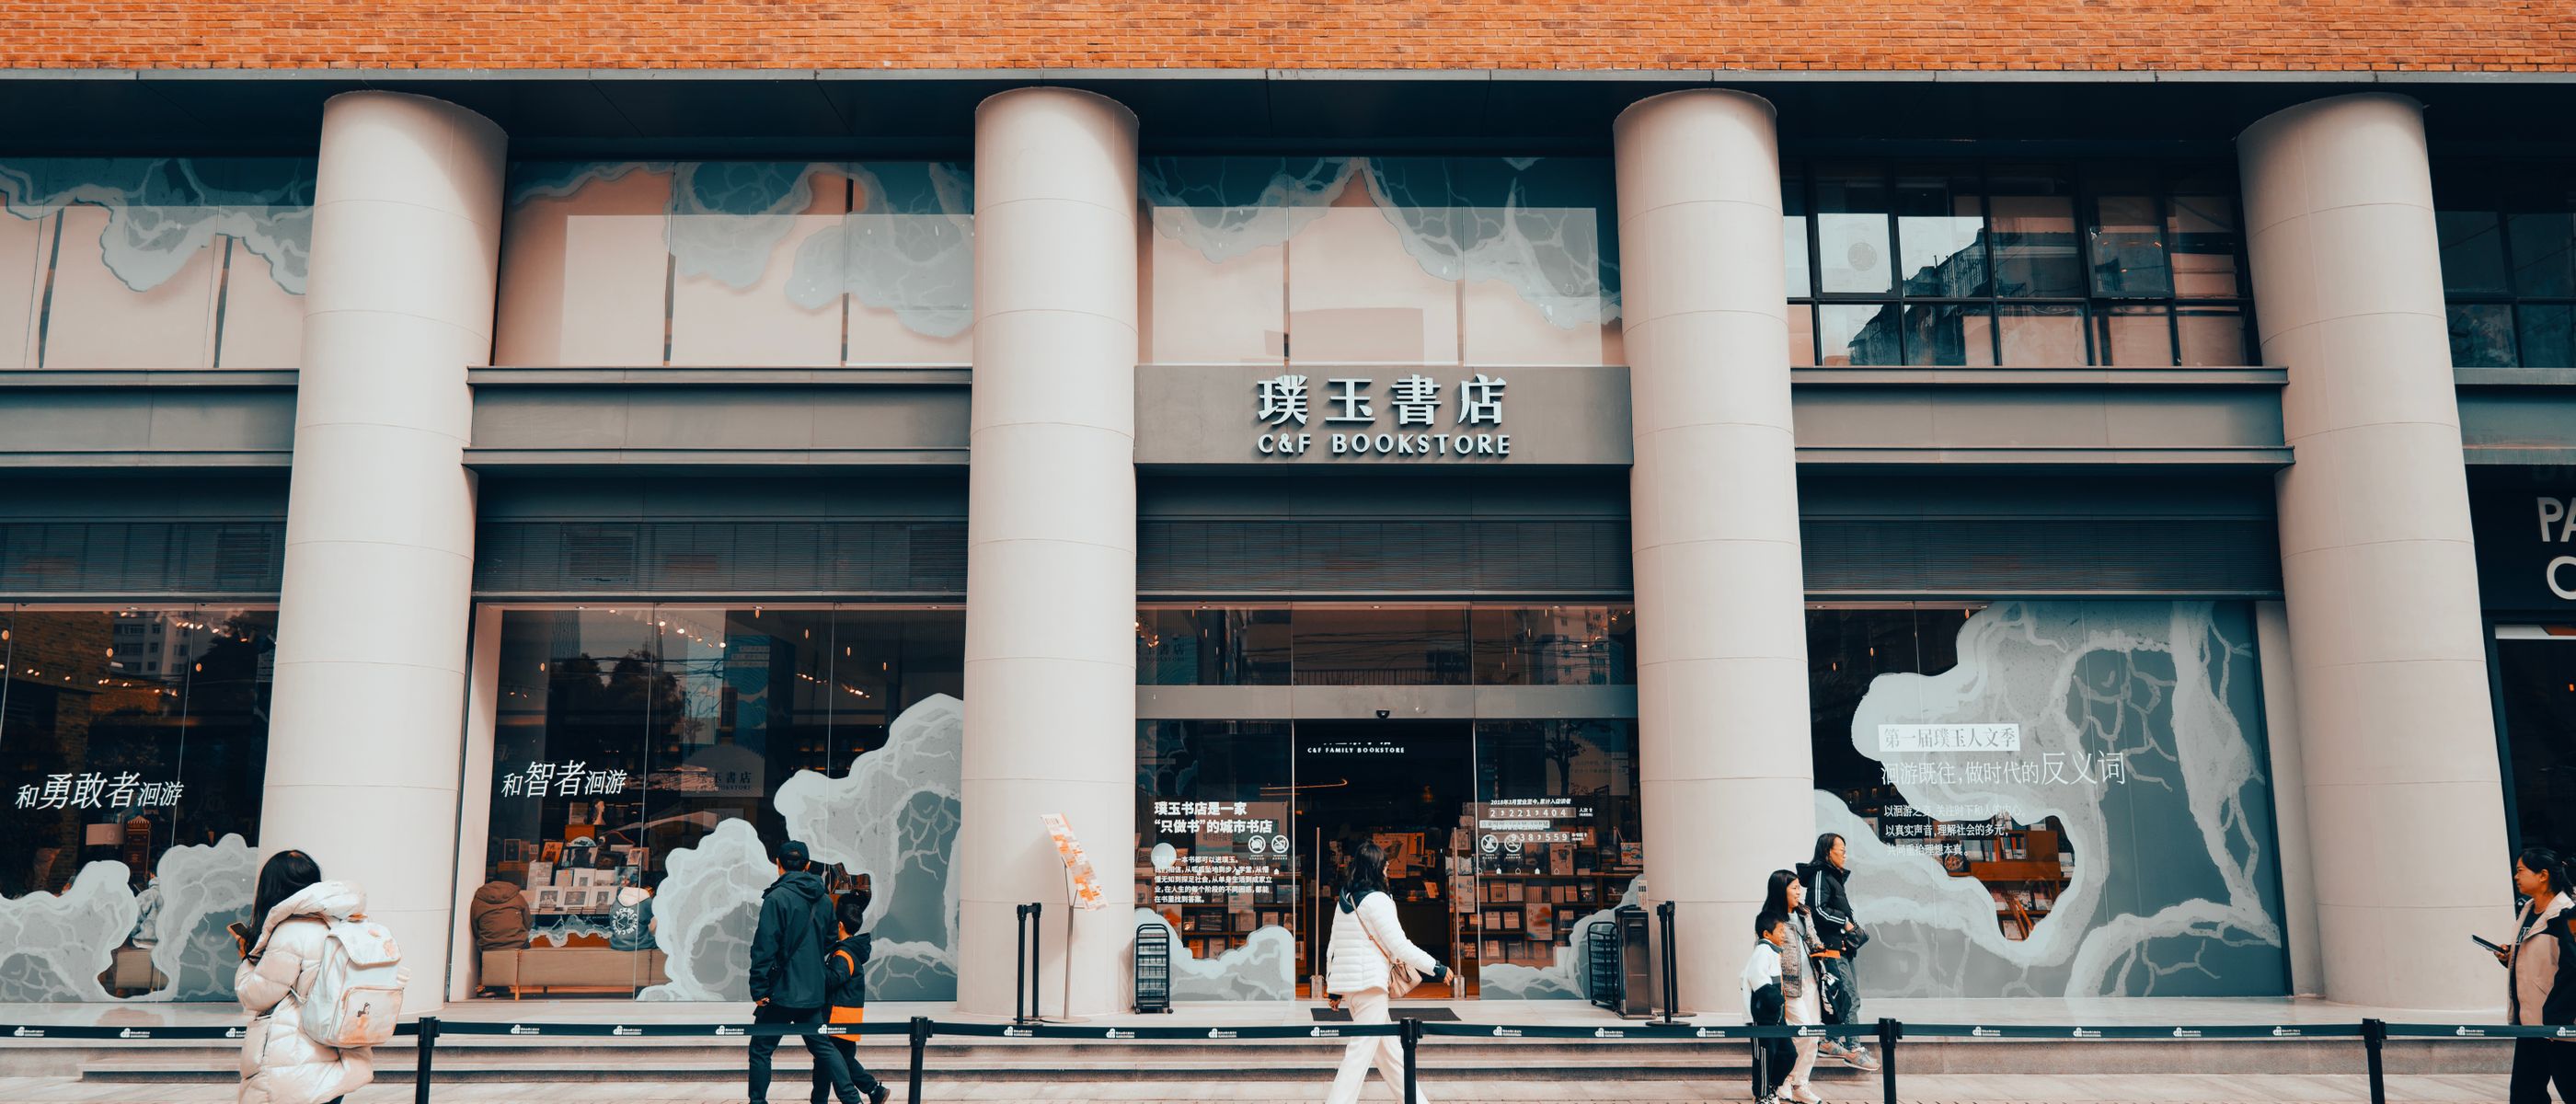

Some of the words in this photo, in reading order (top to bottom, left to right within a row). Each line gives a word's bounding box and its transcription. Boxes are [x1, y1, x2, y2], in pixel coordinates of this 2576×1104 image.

[1258, 374, 1507, 425] 璞玉書店
[1258, 433, 1311, 454] C&F
[1332, 433, 1511, 454] BOOKSTORE
[1885, 728, 2016, 748] 第一届璞玉人文季
[500, 760, 627, 798] 和智者洄游
[15, 771, 184, 810] 和勇敢者洄游
[1154, 801, 1248, 816] 璞玉书店是一家
[1154, 819, 1274, 834] “只做书”的城市书店
